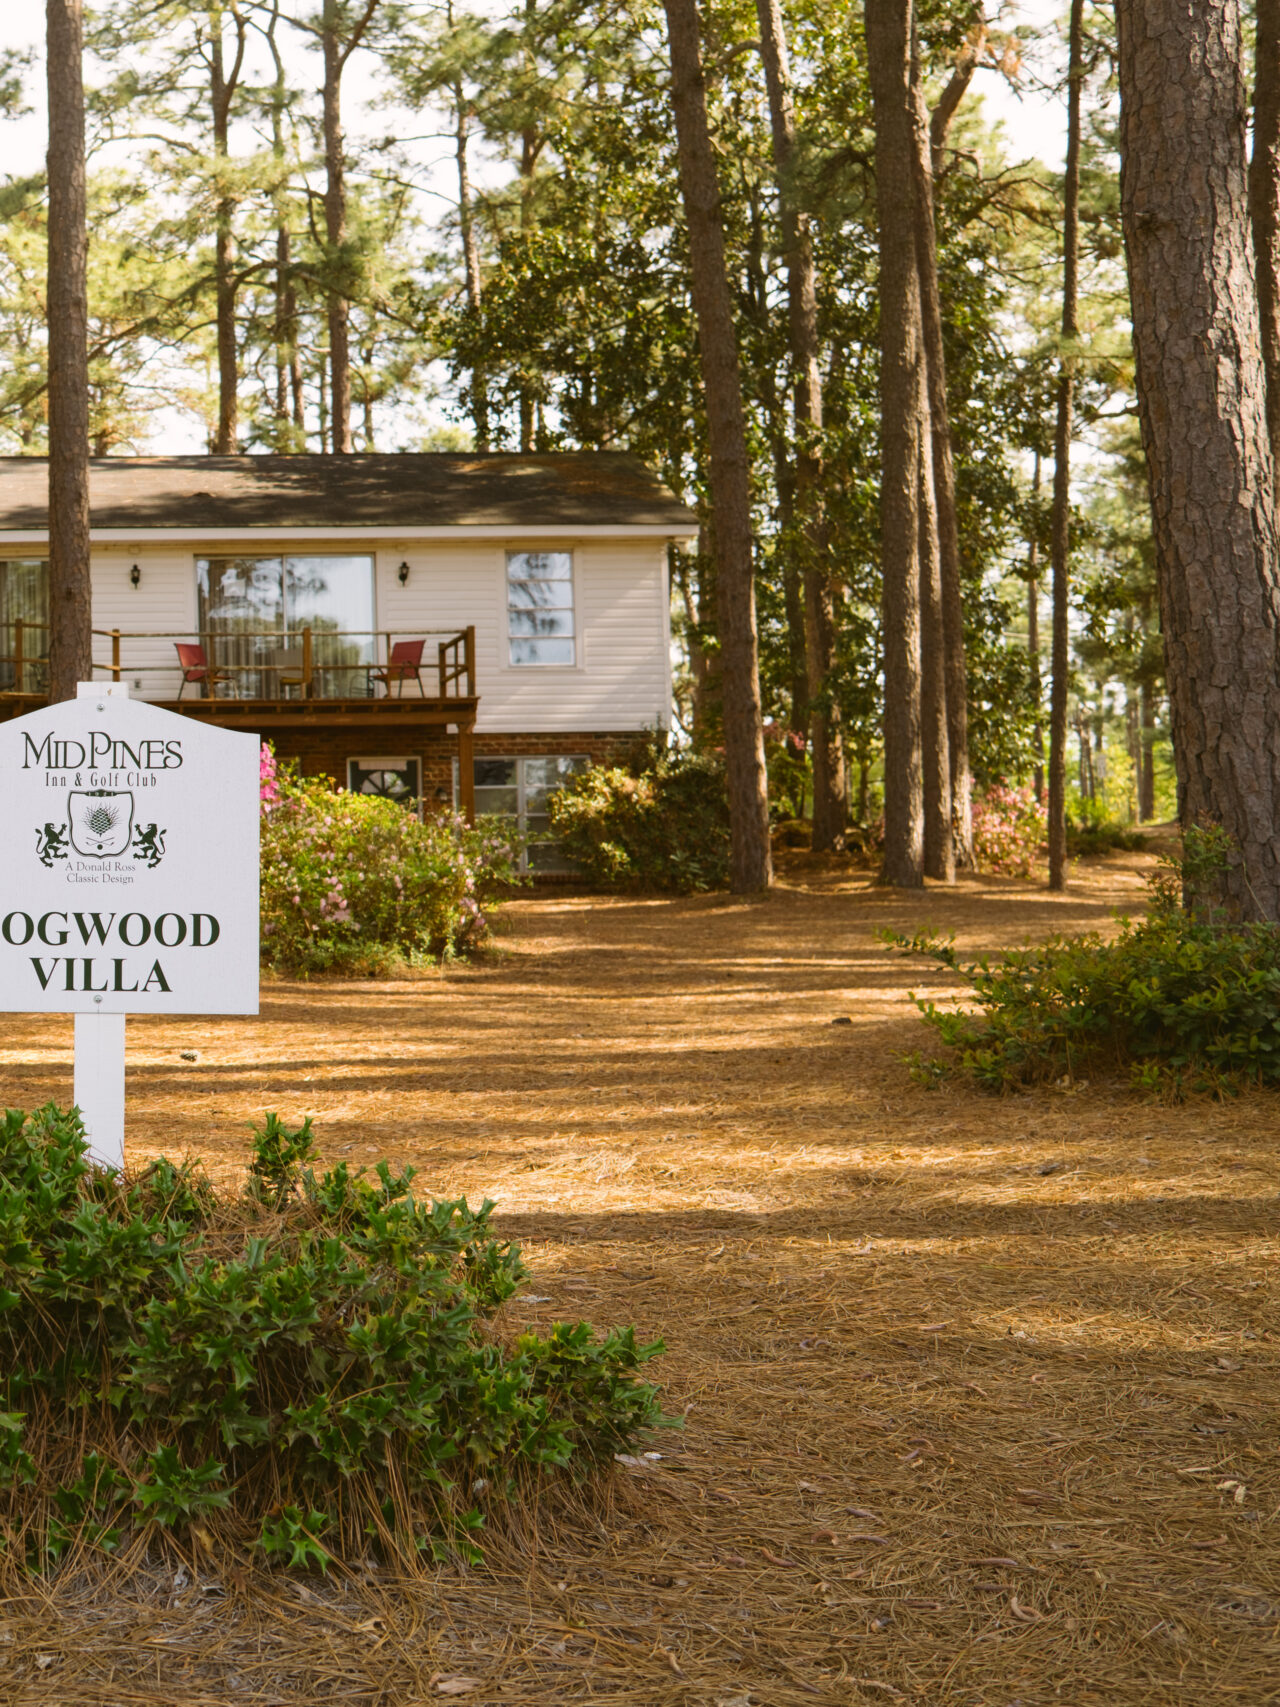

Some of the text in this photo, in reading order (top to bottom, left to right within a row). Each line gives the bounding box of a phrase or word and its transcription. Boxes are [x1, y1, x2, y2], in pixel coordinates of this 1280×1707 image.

[45, 772, 157, 787] Inn & Golf Club
[65, 861, 136, 872] A Donald Ross
[66, 873, 134, 885] Classic Design
[29, 957, 173, 992] VILLA
